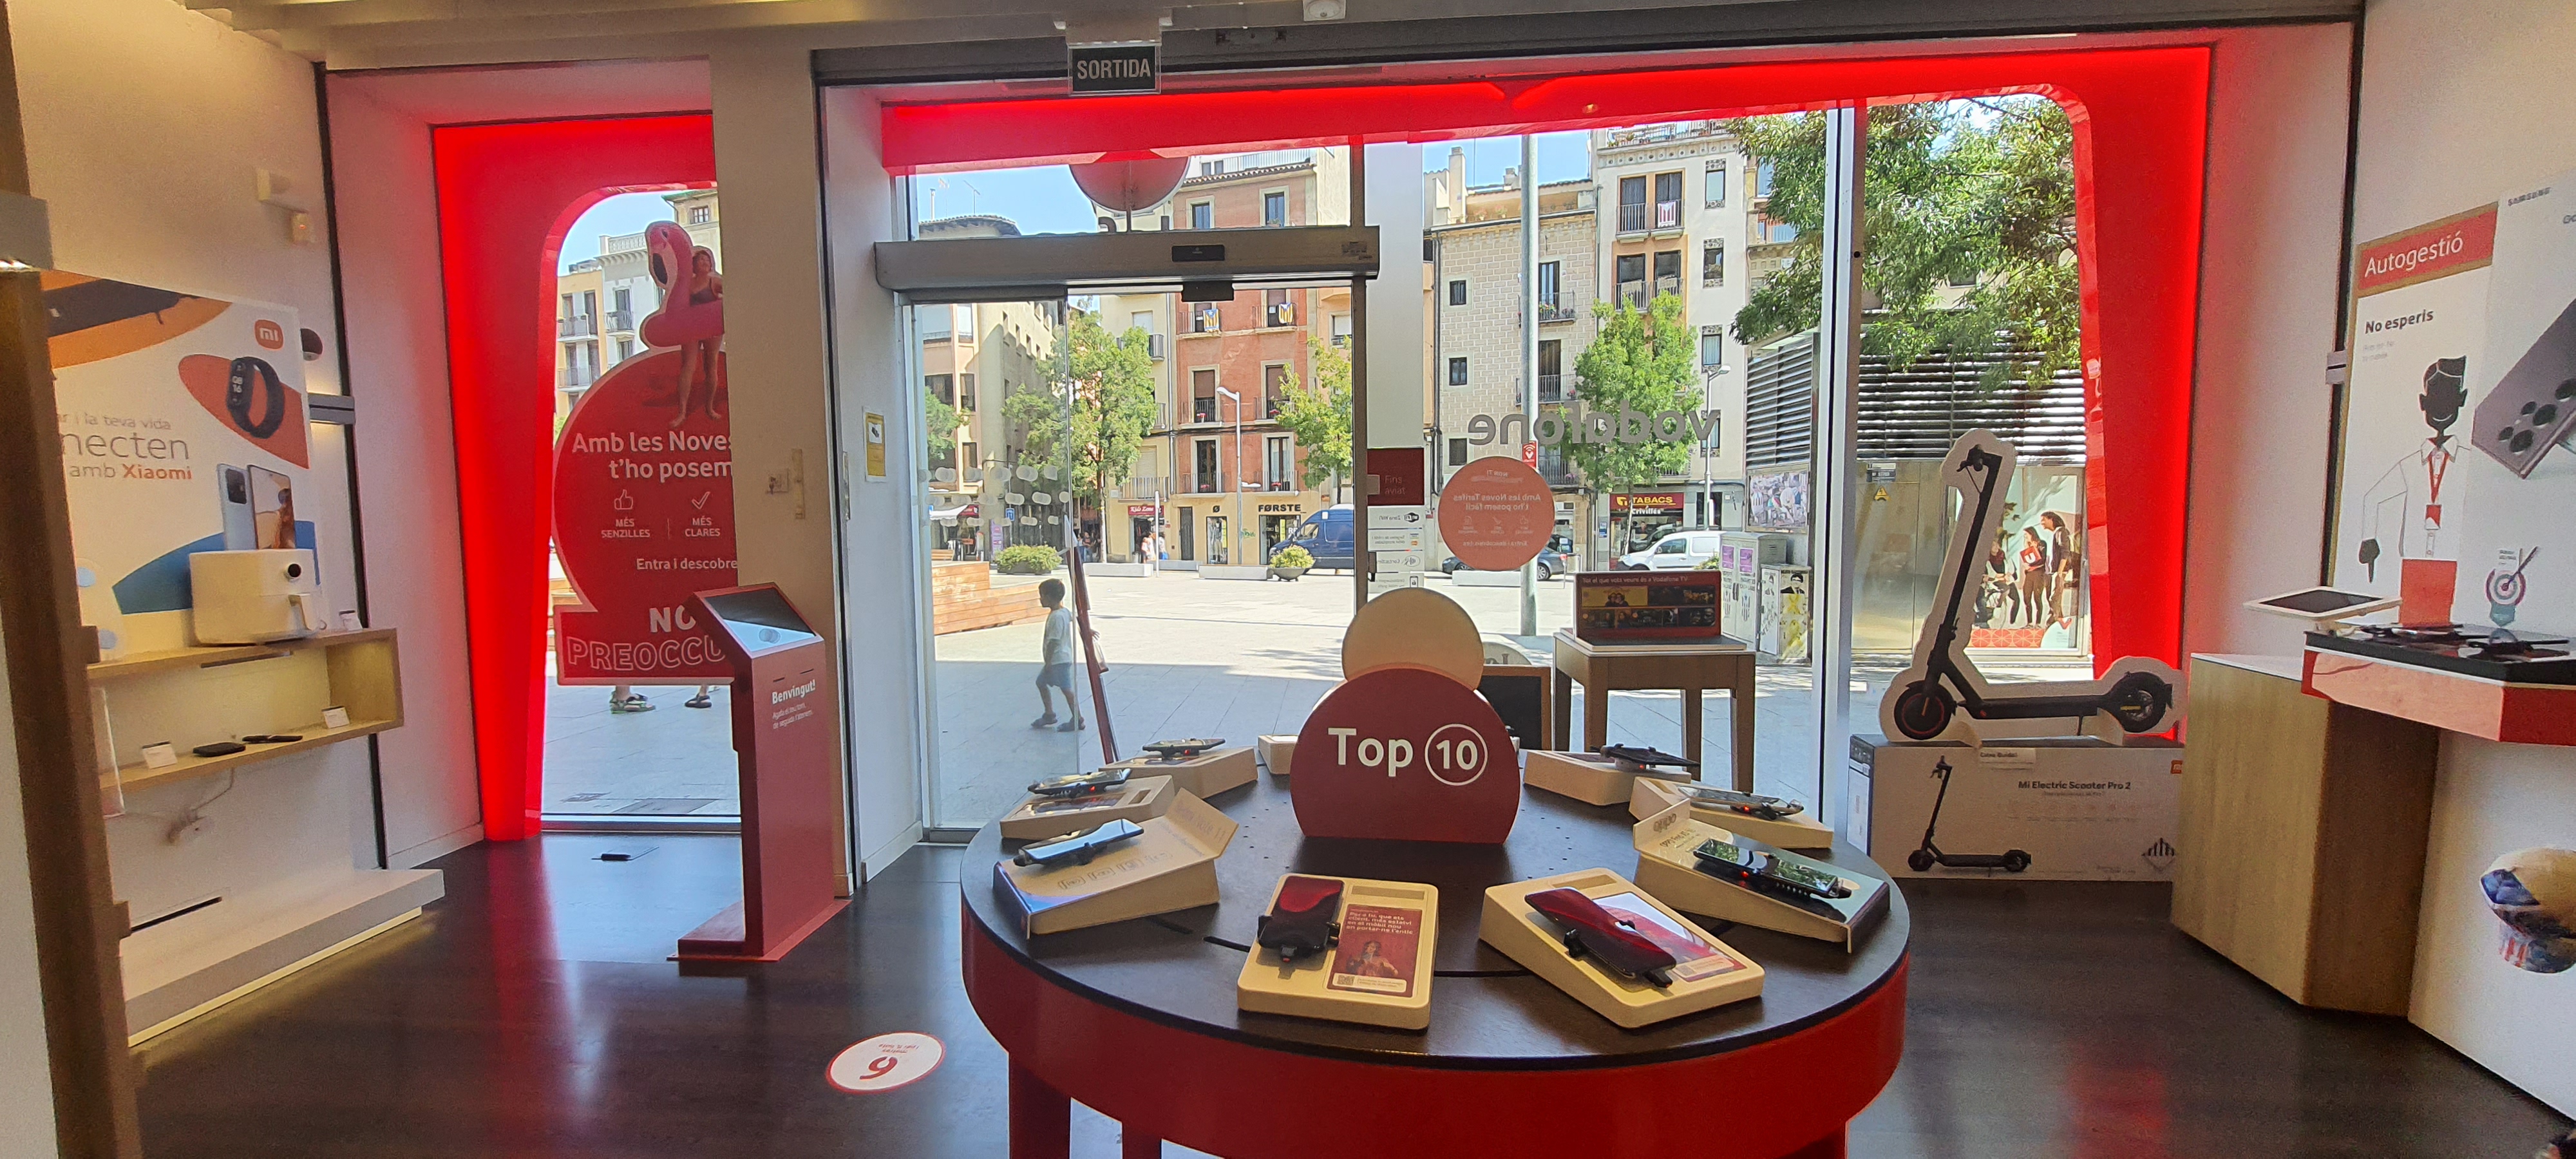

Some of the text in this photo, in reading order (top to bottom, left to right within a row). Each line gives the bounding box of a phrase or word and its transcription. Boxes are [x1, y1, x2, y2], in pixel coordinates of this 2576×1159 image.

[1077, 59, 1151, 79] SORTIDA
[2365, 231, 2463, 278] Autogestió
[2365, 309, 2434, 334] No esperis
[104, 415, 136, 428] teva
[139, 418, 171, 430] vida
[572, 432, 625, 453] Amb
[629, 431, 663, 452] les
[70, 463, 192, 480] amb Xiaomi
[609, 458, 732, 483] t'ho posem
[1385, 475, 1403, 484] Fins
[1384, 486, 1406, 495] aviat
[1258, 504, 1302, 513] FØRSTE
[615, 517, 635, 527] MÉS
[692, 516, 712, 526] MÉS
[601, 529, 650, 539] SENZILLES
[685, 528, 721, 538] CLARES
[636, 558, 670, 570] Entra
[673, 558, 677, 569] i
[772, 679, 816, 704] Benvingut!
[1328, 728, 1478, 777] Top 10
[2018, 780, 2132, 790] Mi Electric Scooter Pro 2
